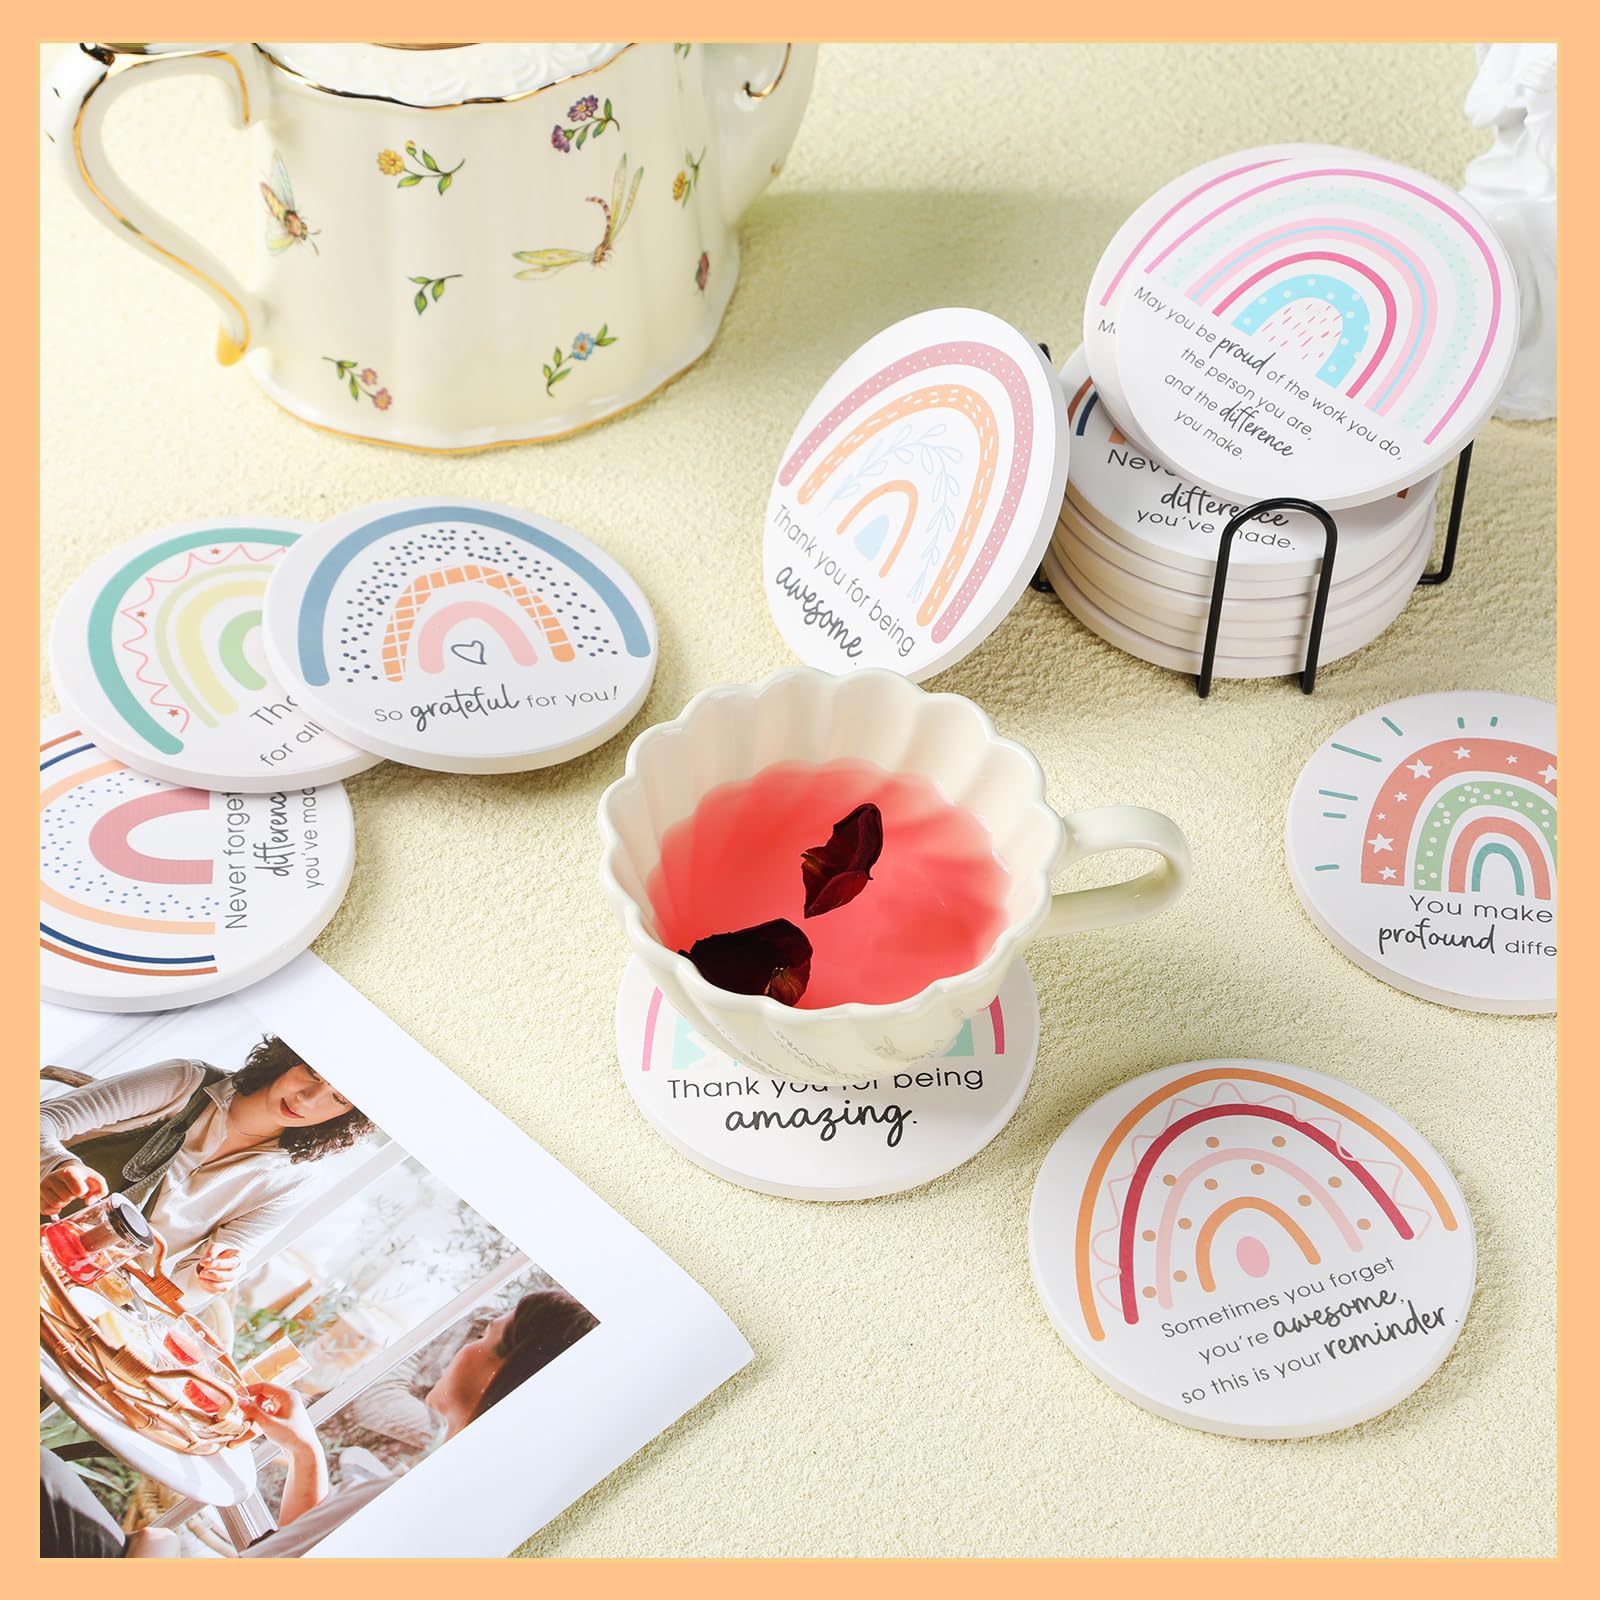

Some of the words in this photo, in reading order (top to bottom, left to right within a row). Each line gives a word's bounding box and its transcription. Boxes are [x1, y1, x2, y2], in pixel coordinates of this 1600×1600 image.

[1134, 286, 1167, 312] May
[1165, 308, 1196, 330] you
[1195, 324, 1217, 343] be
[1208, 337, 1276, 375] proud
[1266, 367, 1287, 387] of
[1285, 377, 1310, 400] the
[1311, 396, 1347, 425] work
[1346, 418, 1378, 442] you
[1379, 434, 1403, 461] do,
[1180, 347, 1206, 368] the
[1204, 365, 1255, 401] person
[1254, 395, 1286, 420] you
[1285, 415, 1312, 441] are,
[1164, 373, 1194, 398] and
[1194, 387, 1219, 412] the
[1218, 401, 1294, 457] difference
[1174, 409, 1202, 432] you
[1201, 425, 1244, 459] make.
[1137, 510, 1216, 533] you've
[1160, 483, 1290, 527] differece
[773, 504, 818, 558] Thank
[814, 551, 847, 585] you
[845, 578, 871, 607] for
[868, 600, 916, 657] being
[775, 566, 863, 666] awesome.
[374, 708, 404, 723] So
[409, 684, 520, 732] grateful
[525, 693, 564, 708] for
[564, 685, 618, 708] you!
[260, 742, 294, 766] for
[296, 721, 324, 743] all
[221, 792, 251, 856] forget
[301, 829, 325, 889] you've
[224, 863, 248, 929] Never
[1408, 895, 1462, 915] You
[1473, 904, 1553, 923] make
[1378, 917, 1496, 955] profound
[1504, 939, 1557, 957] diffe
[667, 1075, 760, 1099] Thank
[893, 1067, 984, 1091] being
[725, 1099, 918, 1148] amazing.
[1161, 1294, 1280, 1338] Sometimes
[1283, 1279, 1325, 1304] you
[1328, 1256, 1395, 1289] forget
[1198, 1333, 1270, 1364] you're
[1273, 1288, 1405, 1339] awesome,
[1181, 1387, 1206, 1405] so
[1210, 1371, 1249, 1395] this
[1252, 1366, 1270, 1382] is
[1273, 1351, 1323, 1379] your
[1324, 1300, 1459, 1360] reminder.
